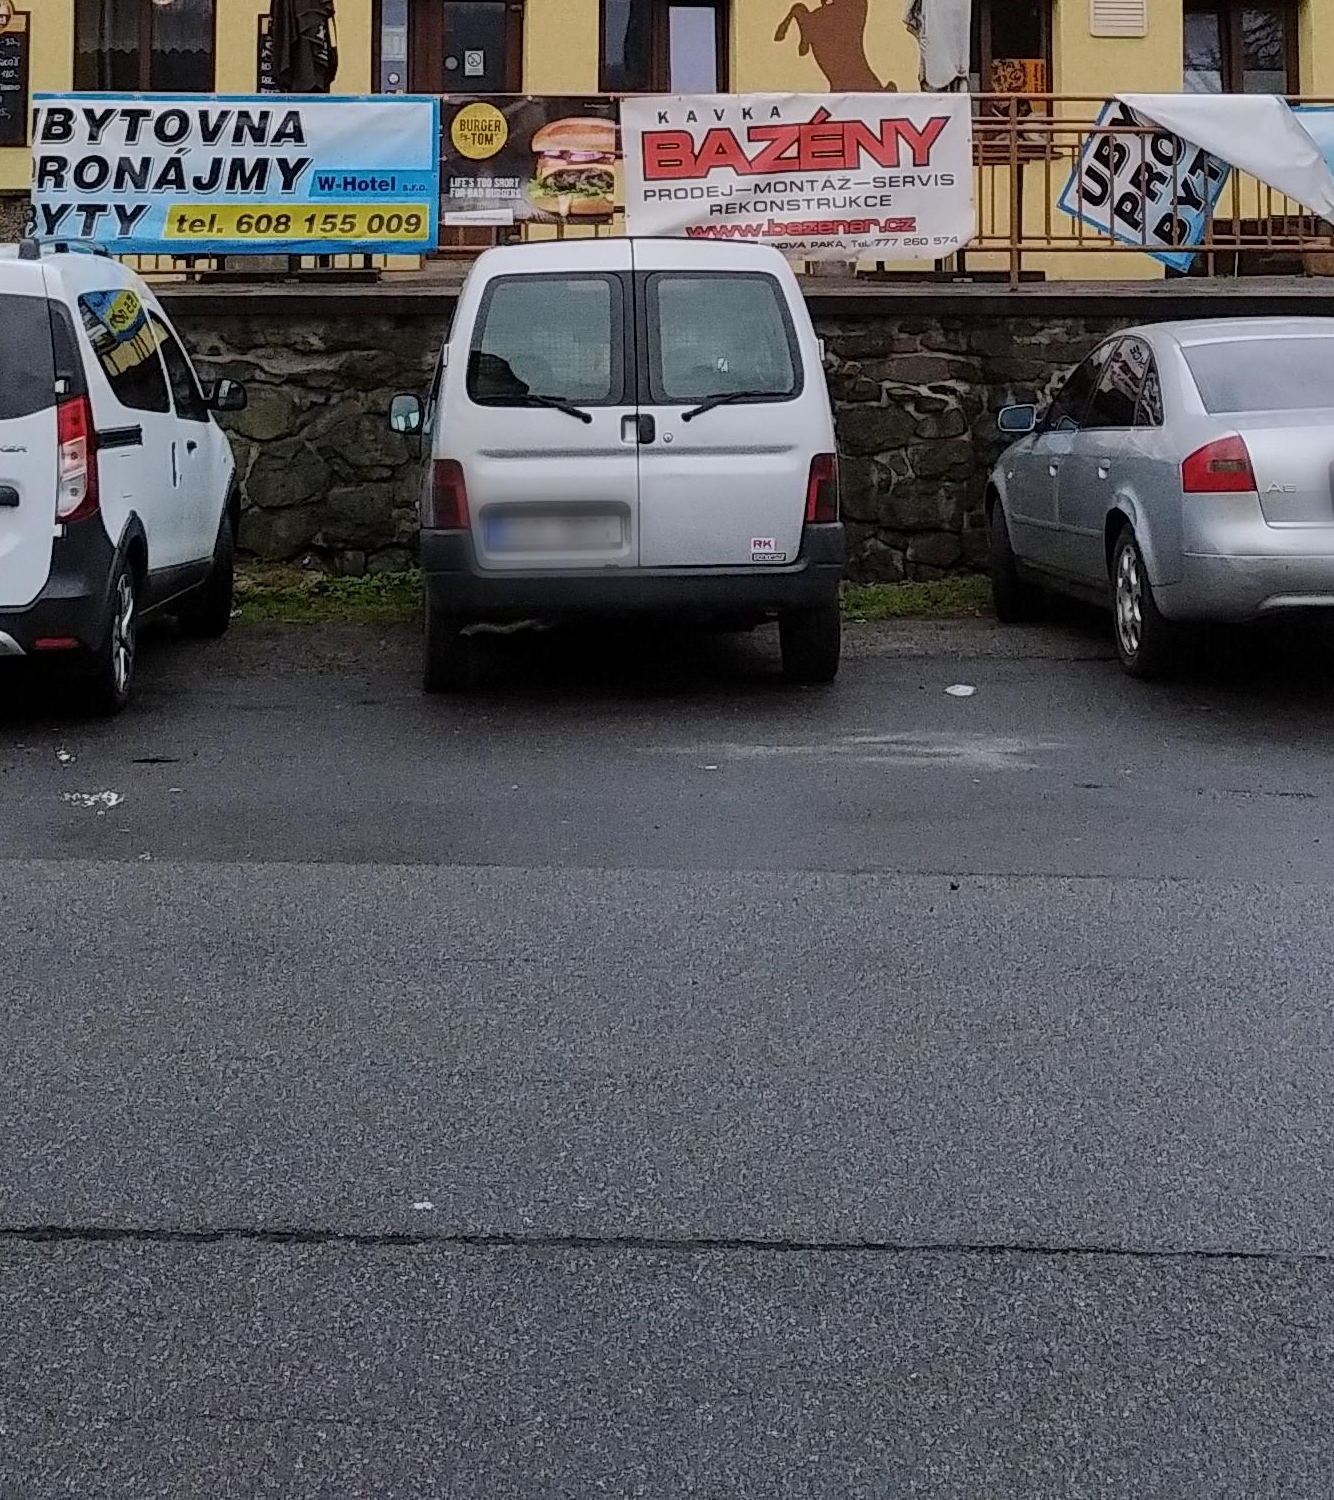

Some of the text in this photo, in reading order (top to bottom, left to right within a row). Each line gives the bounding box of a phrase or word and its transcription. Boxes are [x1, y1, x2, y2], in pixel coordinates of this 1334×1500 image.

[658, 106, 781, 124] KAVKA
[459, 119, 501, 132] BURGER
[471, 133, 494, 145] TOM
[641, 105, 952, 181] BAZÉNY
[32, 148, 314, 194] RONÁJMY
[317, 175, 428, 192] W-Hotel s.r.o.
[710, 194, 892, 216] REKONSTRUKCE
[176, 213, 422, 234] tel. 608 155 009
[685, 216, 916, 238] www.bazenar.cz
[874, 238, 899, 247] 777
[903, 237, 929, 246] 260
[933, 235, 959, 245] 574
[753, 539, 772, 549] RK
